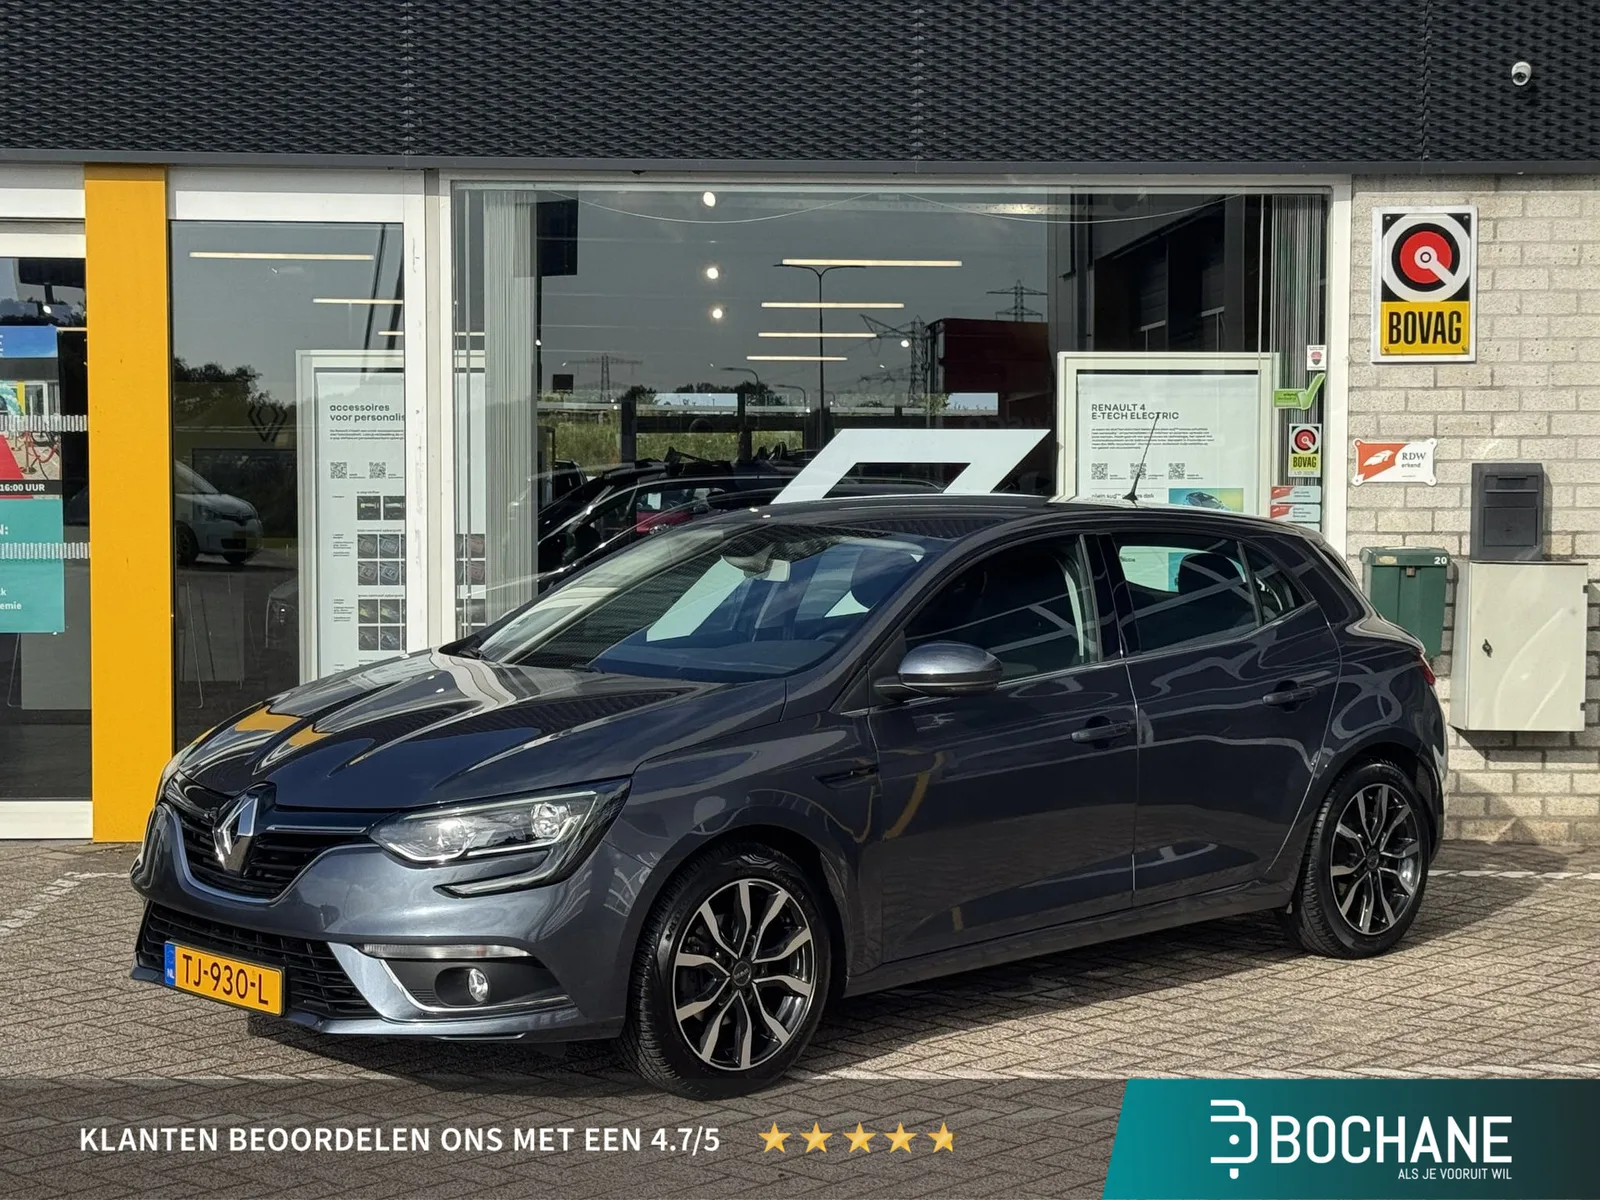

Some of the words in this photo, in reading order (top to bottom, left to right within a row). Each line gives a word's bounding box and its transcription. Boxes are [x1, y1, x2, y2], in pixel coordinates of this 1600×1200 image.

[1388, 310, 1462, 345] BOVAG
[329, 403, 390, 411] accessoires
[1091, 403, 1138, 411] RENAULT
[1139, 403, 1146, 411] 4
[1091, 412, 1128, 420] E-TECH
[1130, 412, 1179, 420] ELECTRIC
[1401, 452, 1426, 461] RDW
[1292, 456, 1317, 468] BOVAG
[0, 483, 24, 492] 16:00
[25, 483, 46, 492] UUR
[1434, 556, 1448, 565] 20
[166, 968, 175, 980] NL
[182, 953, 269, 1006] TJ-930-L
